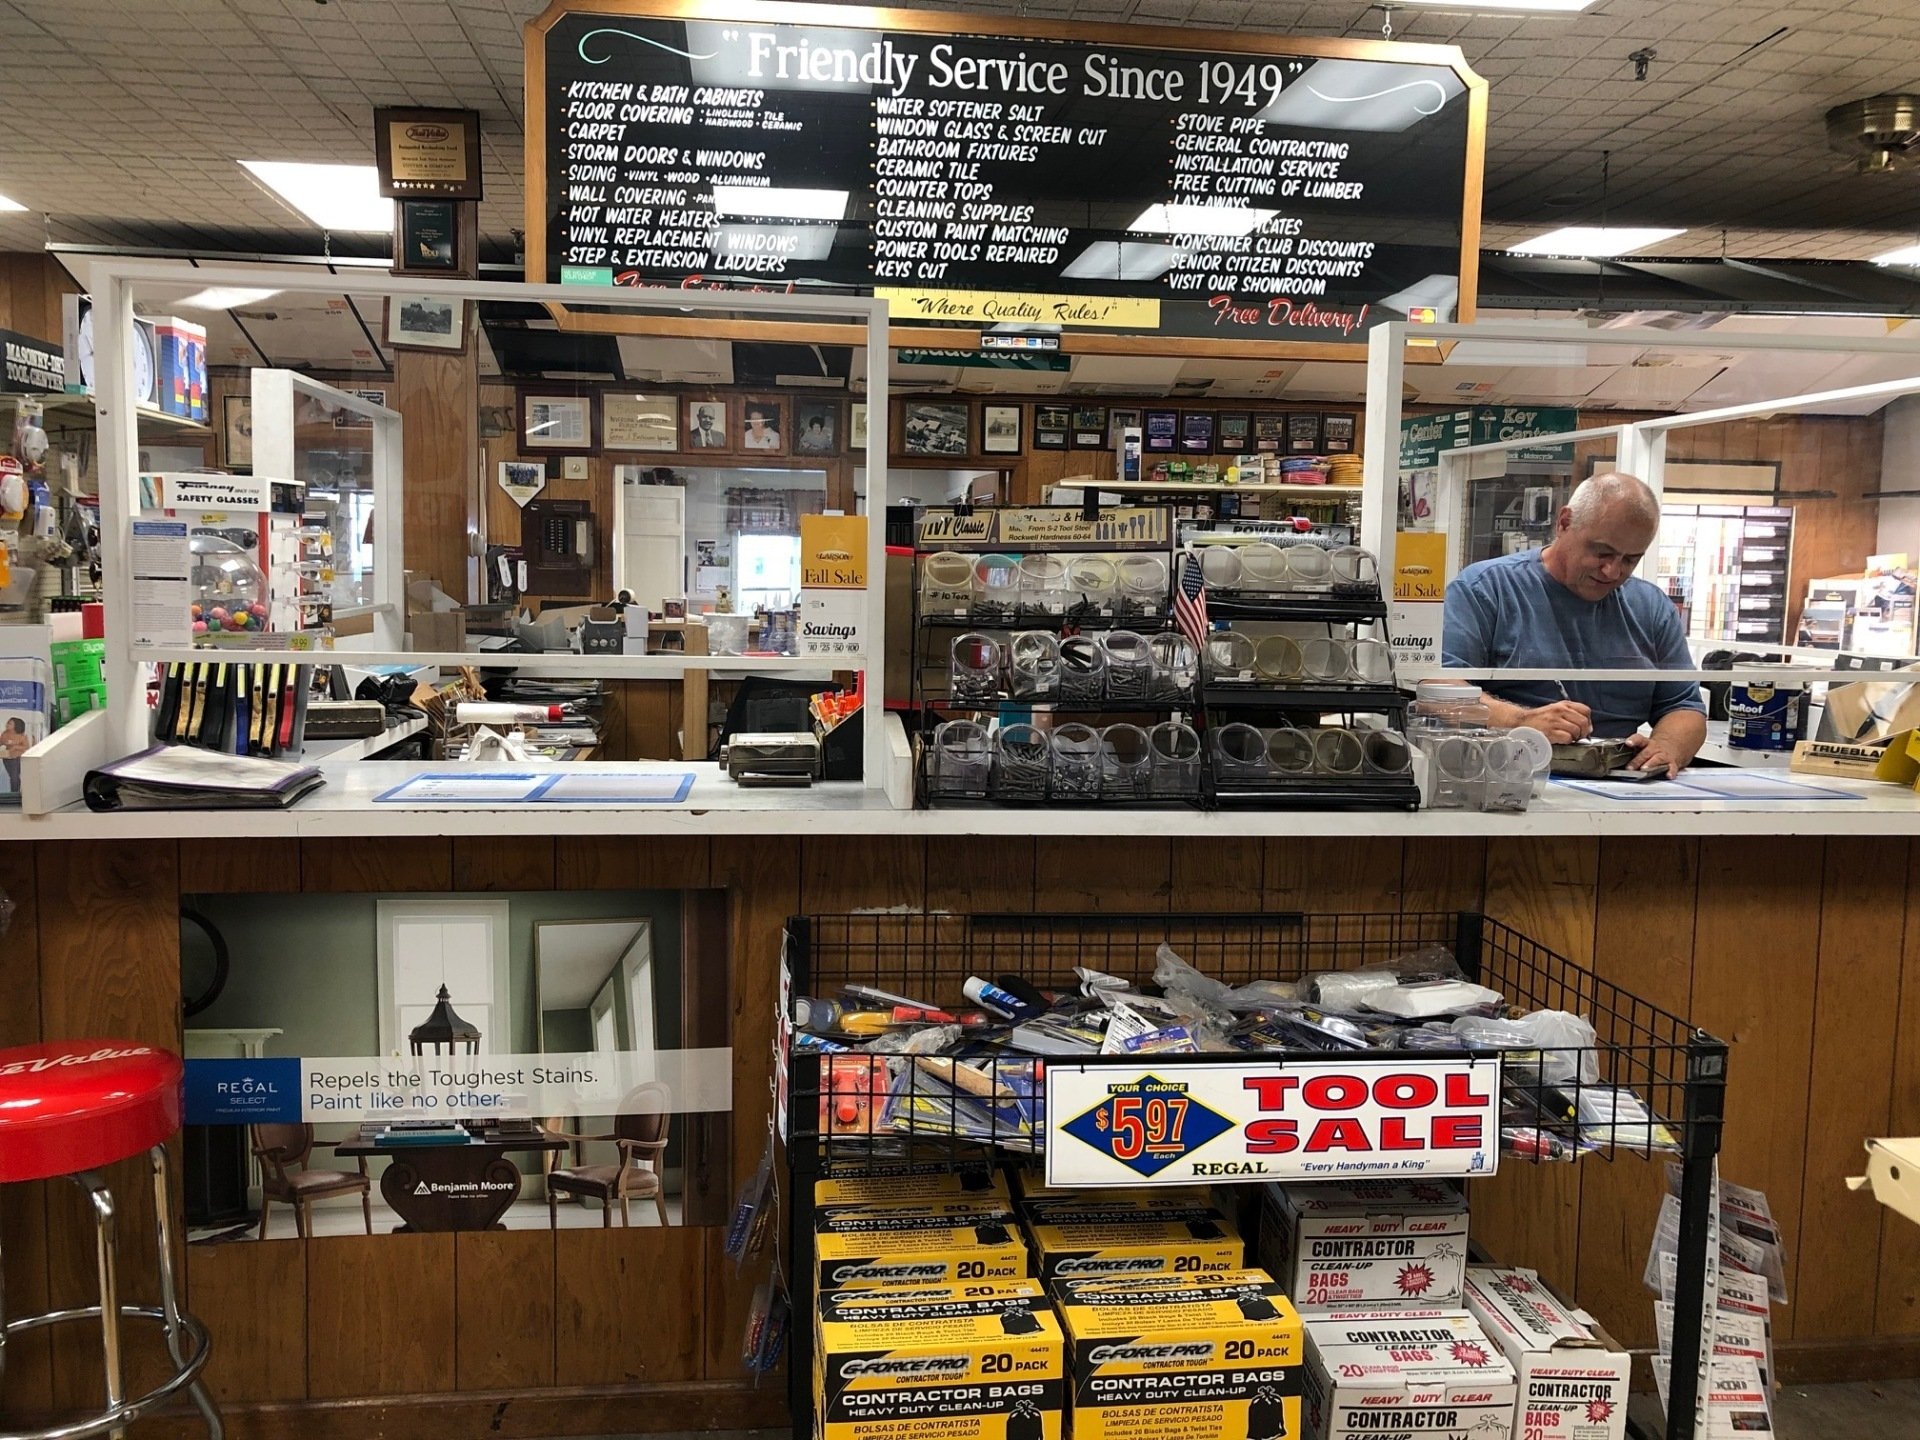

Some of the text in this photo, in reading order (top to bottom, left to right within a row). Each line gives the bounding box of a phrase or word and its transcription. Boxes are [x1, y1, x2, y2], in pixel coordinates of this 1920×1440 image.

[723, 31, 1302, 108] "Friendly Service Since 1949"
[568, 81, 764, 107] KITCHEN & BATH CABINETS
[568, 102, 784, 125] FLOOR COVERING LINOLEUM TILE
[877, 97, 1044, 122] WATER SOFTENER SALT
[568, 122, 626, 140] CARPET
[705, 118, 803, 131] HARDWOOD CERAMIC
[877, 117, 1106, 146] WINDOW GLASS & SCREEN CUT
[1176, 113, 1266, 135] STOVE PIPE
[568, 143, 766, 169] STORM DOORS & WINDOWS
[877, 137, 1038, 162] BATHROOM FIXTURES
[1176, 134, 1349, 159] GENERAL CONTRACTING
[568, 165, 770, 187] SIDING VINYL WOOD ALUMINUM
[876, 158, 980, 180] CERAMIC TILE
[1175, 154, 1340, 178] INSTALLATION SERVICE
[569, 185, 606, 203] WALL
[615, 189, 687, 206] COVERING
[876, 178, 993, 200] COUNTER TOPS
[1174, 174, 1363, 200] FREE CUTTING OF LUMBER
[570, 206, 721, 229] HOT WATER HEATERS
[877, 199, 1034, 222] CLEANING SUPPLIES
[570, 226, 798, 252] VINYL REPLACEMENT WINDOWS
[876, 219, 1068, 245] CUSTOM PAINT MATCHING
[875, 240, 1058, 264] POWER TOOLS REPAIRED
[1172, 234, 1374, 258] CONSUMER CLUB DISCOUNTS
[568, 246, 787, 272] STEP & EXTENSION LADDERS
[875, 260, 948, 279] KEYS CUT
[1170, 253, 1364, 277] SENIOR CITIZEN DISCOUNTS
[1169, 273, 1326, 295] VISIT OUR SHOWROOM
[911, 298, 1117, 321] "Where Quality Rules!"
[1208, 294, 1369, 336] Free Delivery!
[1502, 409, 1537, 427] Key
[176, 494, 259, 505] SAFETY GLASSES
[953, 517, 984, 537] Classic
[805, 569, 863, 584] Fall Sale
[1415, 582, 1440, 597] Sale
[803, 622, 856, 639] Savings
[1392, 634, 1432, 650] avings
[217, 1068, 598, 1094] REGAL Repels the Toughest Stains.
[1111, 1083, 1186, 1093] YOUR CHOICE
[230, 1090, 503, 1110] SELECT Paint like no other.
[1243, 1073, 1489, 1112] TOOL
[1244, 1115, 1482, 1154] SALE
[1153, 1152, 1175, 1160] Each
[1192, 1162, 1269, 1176] REGAL
[1300, 1161, 1333, 1172] "Every
[1336, 1161, 1390, 1172] Handyman
[1401, 1160, 1430, 1171] King"
[431, 1181, 514, 1193] Benjamin Moore
[1324, 1222, 1447, 1234] HEAVY DUTY CLEAR
[1312, 1240, 1415, 1258] CONTRACTOR
[1310, 1262, 1373, 1271] CLEAN-UP
[1310, 1273, 1349, 1288] BAGS
[1171, 1343, 1213, 1355] PRO
[1224, 1340, 1254, 1360] 20
[1257, 1347, 1289, 1357] PACK
[1090, 1370, 1285, 1391] CONTRACTOR BAGS
[842, 1384, 1044, 1406] CONTRACTOR BAGS
[849, 1401, 1004, 1417] HEAVY DUTY CLEAN-UP
